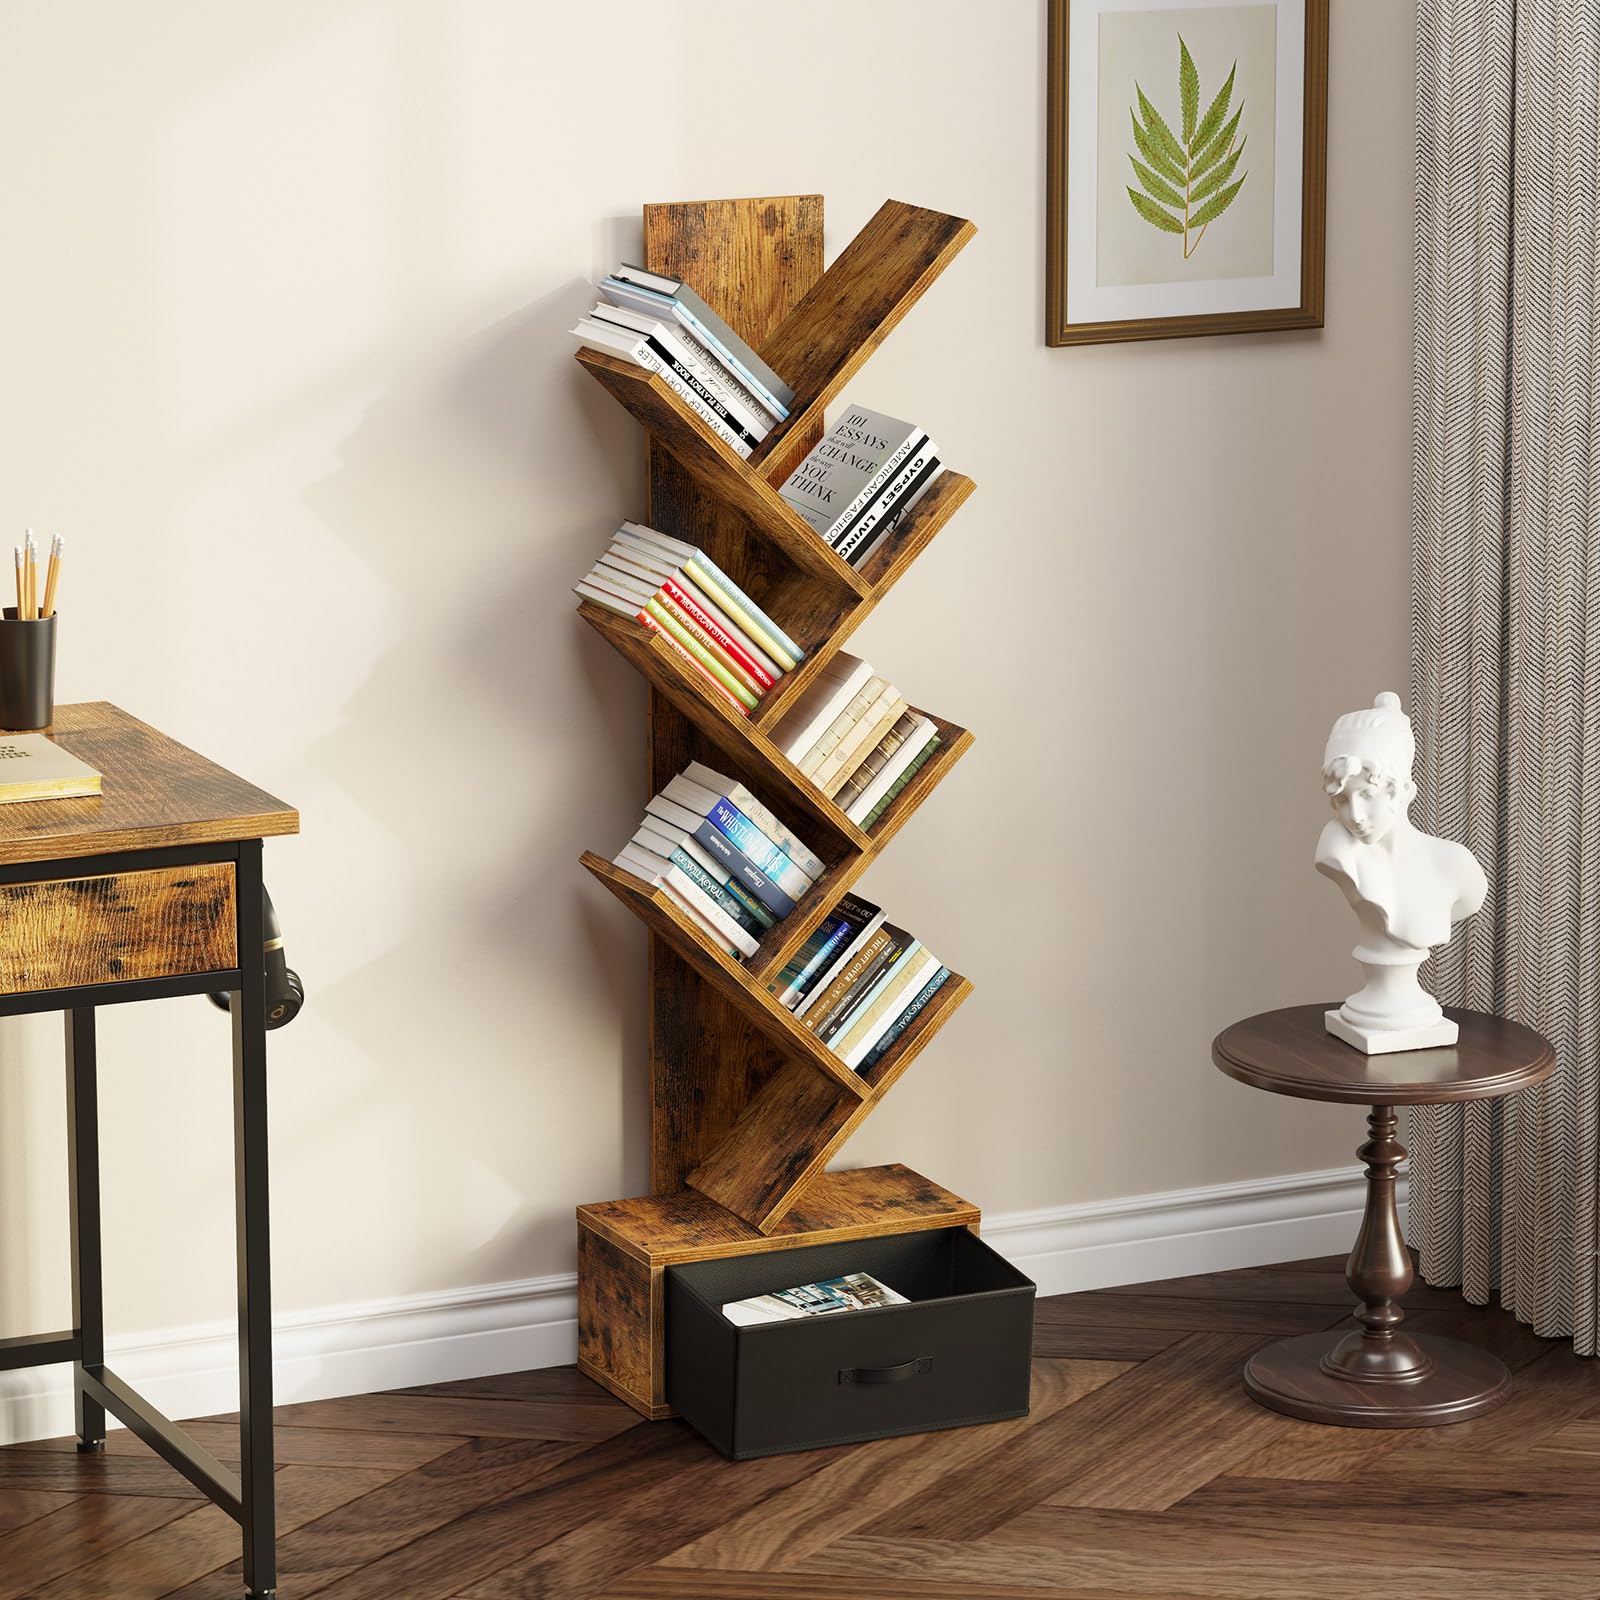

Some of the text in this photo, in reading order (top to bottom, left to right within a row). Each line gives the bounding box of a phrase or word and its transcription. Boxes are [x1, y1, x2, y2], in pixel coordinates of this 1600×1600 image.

[671, 361, 728, 417] THE PLAYBOY BOOK
[681, 334, 764, 416] TIM WALKER STORY TELLER
[636, 348, 736, 445] TIM WALKER STORY TELLER
[846, 414, 868, 428] 101
[835, 425, 889, 450] ESSAYS
[799, 463, 833, 483] YOU
[818, 444, 878, 474] CHANGE
[789, 474, 838, 503] THINK
[825, 442, 911, 542] AMERICAN FASHION
[839, 458, 924, 557] GYPSET LIVING
[672, 608, 698, 632] AFRICAN
[695, 630, 714, 648] STYLE
[680, 598, 714, 630] MOROCCAN
[711, 628, 730, 646] STYLE
[860, 948, 874, 964] GIFT
[872, 936, 884, 949] THE
[844, 962, 862, 982] GIVER
